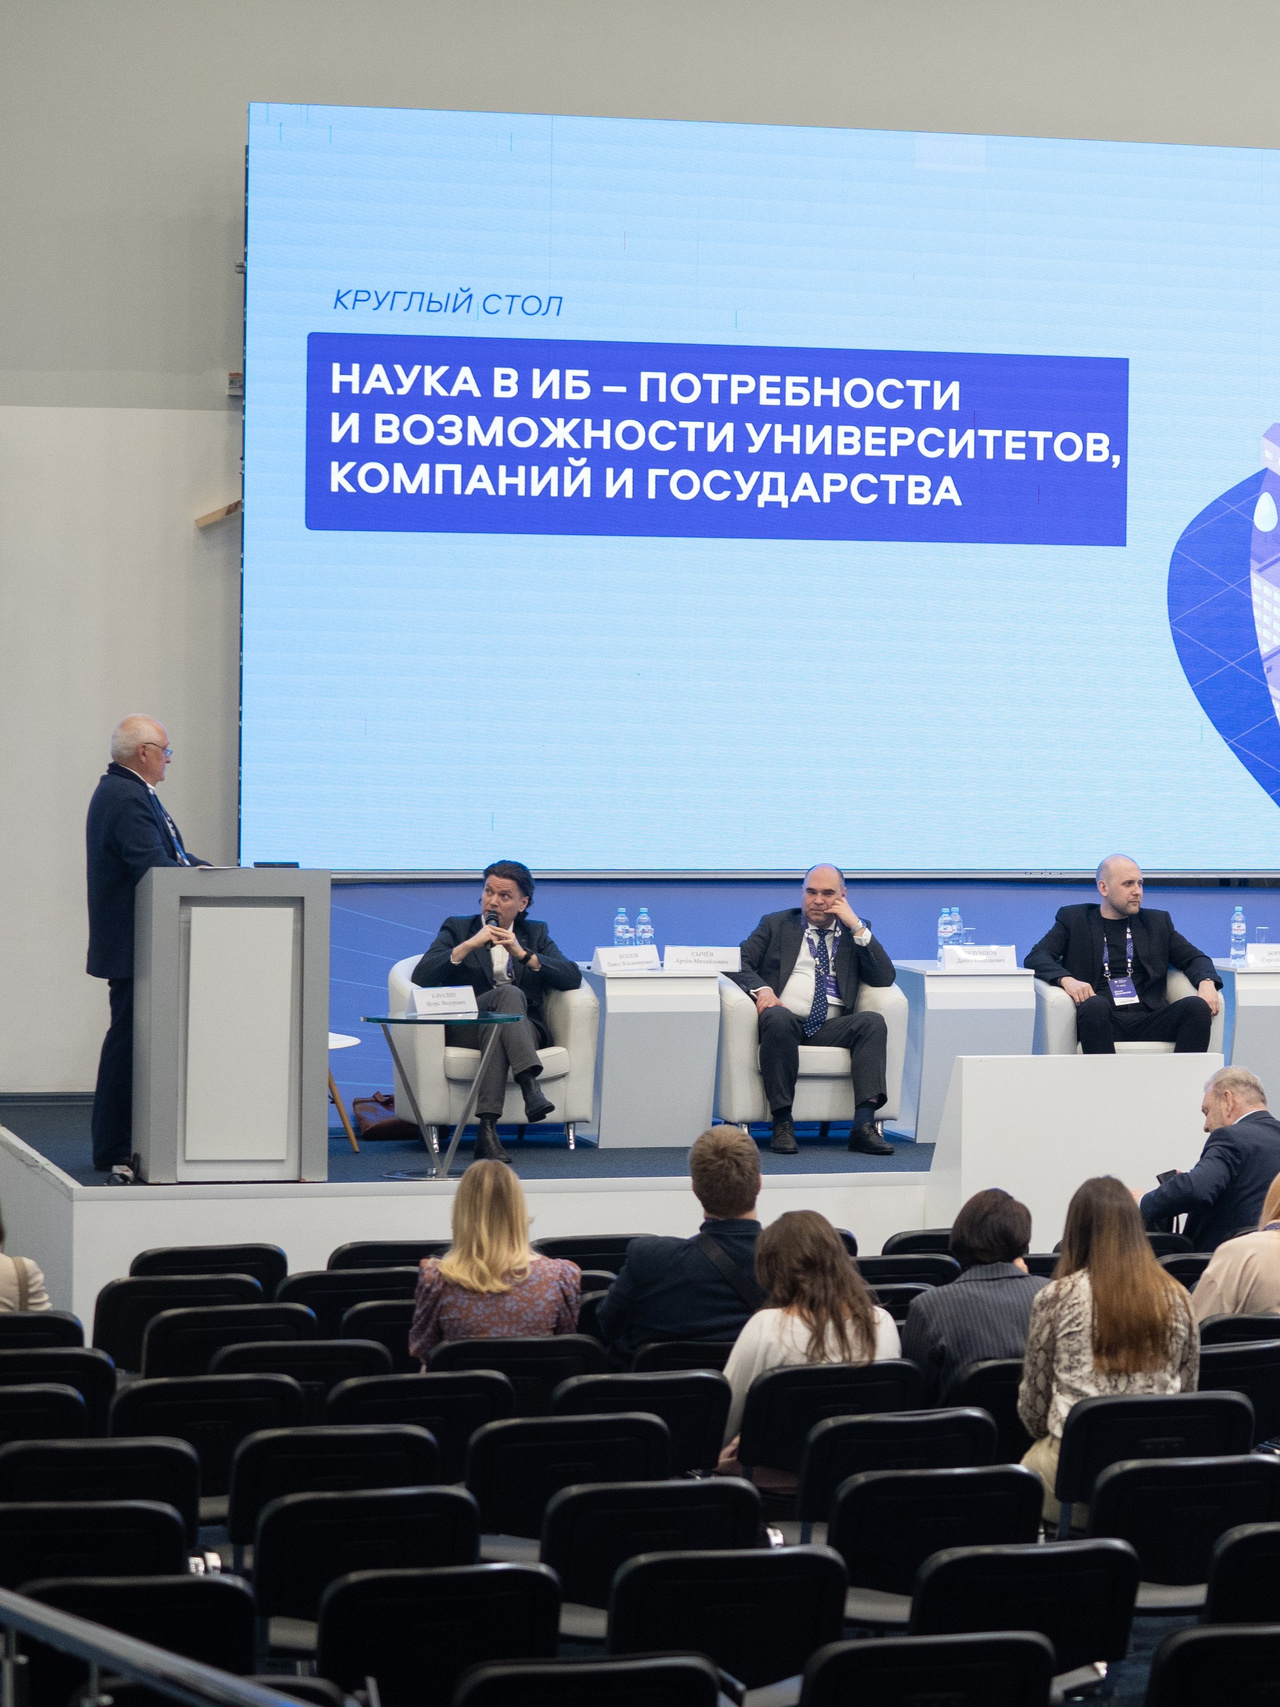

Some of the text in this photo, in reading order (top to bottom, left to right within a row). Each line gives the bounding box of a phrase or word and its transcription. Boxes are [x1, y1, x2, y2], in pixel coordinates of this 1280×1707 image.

[333, 287, 564, 317] КРУГЛЫЙ СТОЛ
[331, 362, 482, 398] НАУКА
[493, 367, 519, 399] В
[532, 368, 592, 400] ИБ
[639, 371, 961, 411] ПОТРЕБНОСТИ
[331, 411, 1122, 469] И ВОЗМОЖНОСТИ УНИВЕРСИТЕТОВ,
[330, 456, 963, 509] КОМПАНИЙ И ГОСУДАРСТВА
